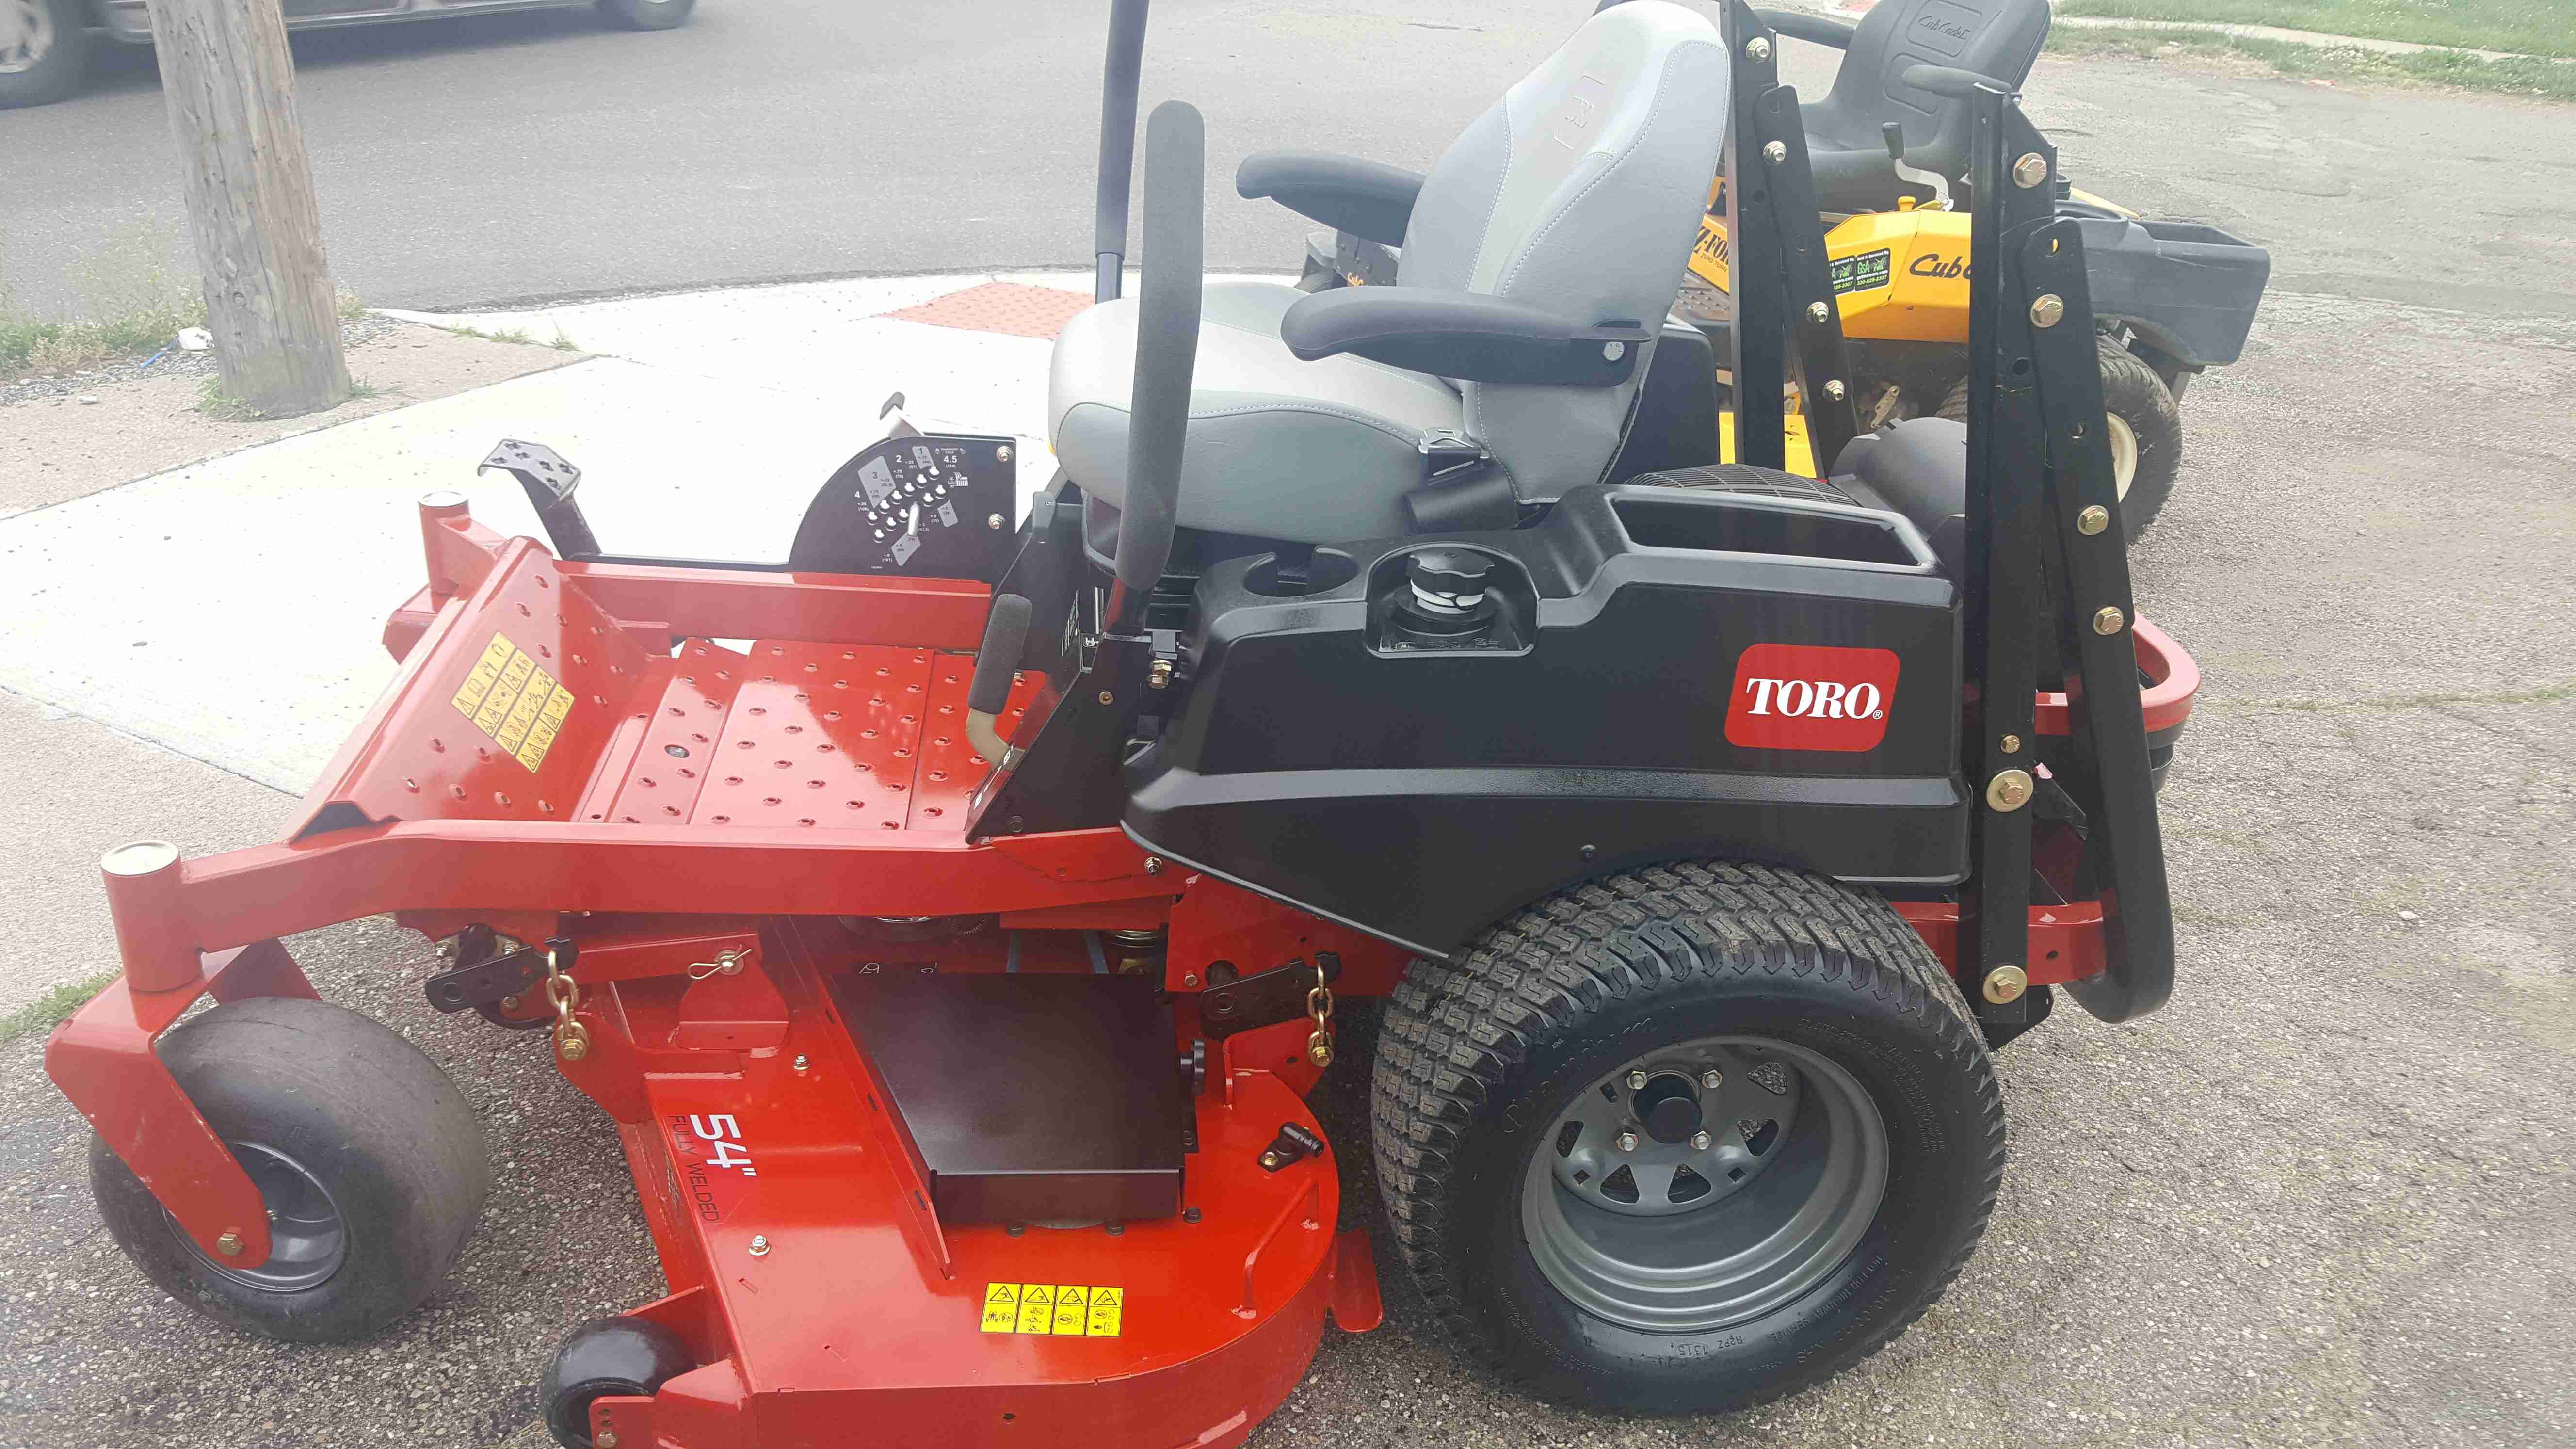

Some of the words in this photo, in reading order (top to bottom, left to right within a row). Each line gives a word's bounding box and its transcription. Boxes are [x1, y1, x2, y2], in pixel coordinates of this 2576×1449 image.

[1910, 253, 1963, 279] Cub
[1746, 678, 1881, 720] TORO
[667, 1115, 698, 1156] FULLY
[686, 1162, 720, 1222] WELDED
[689, 1114, 757, 1177] 54"
